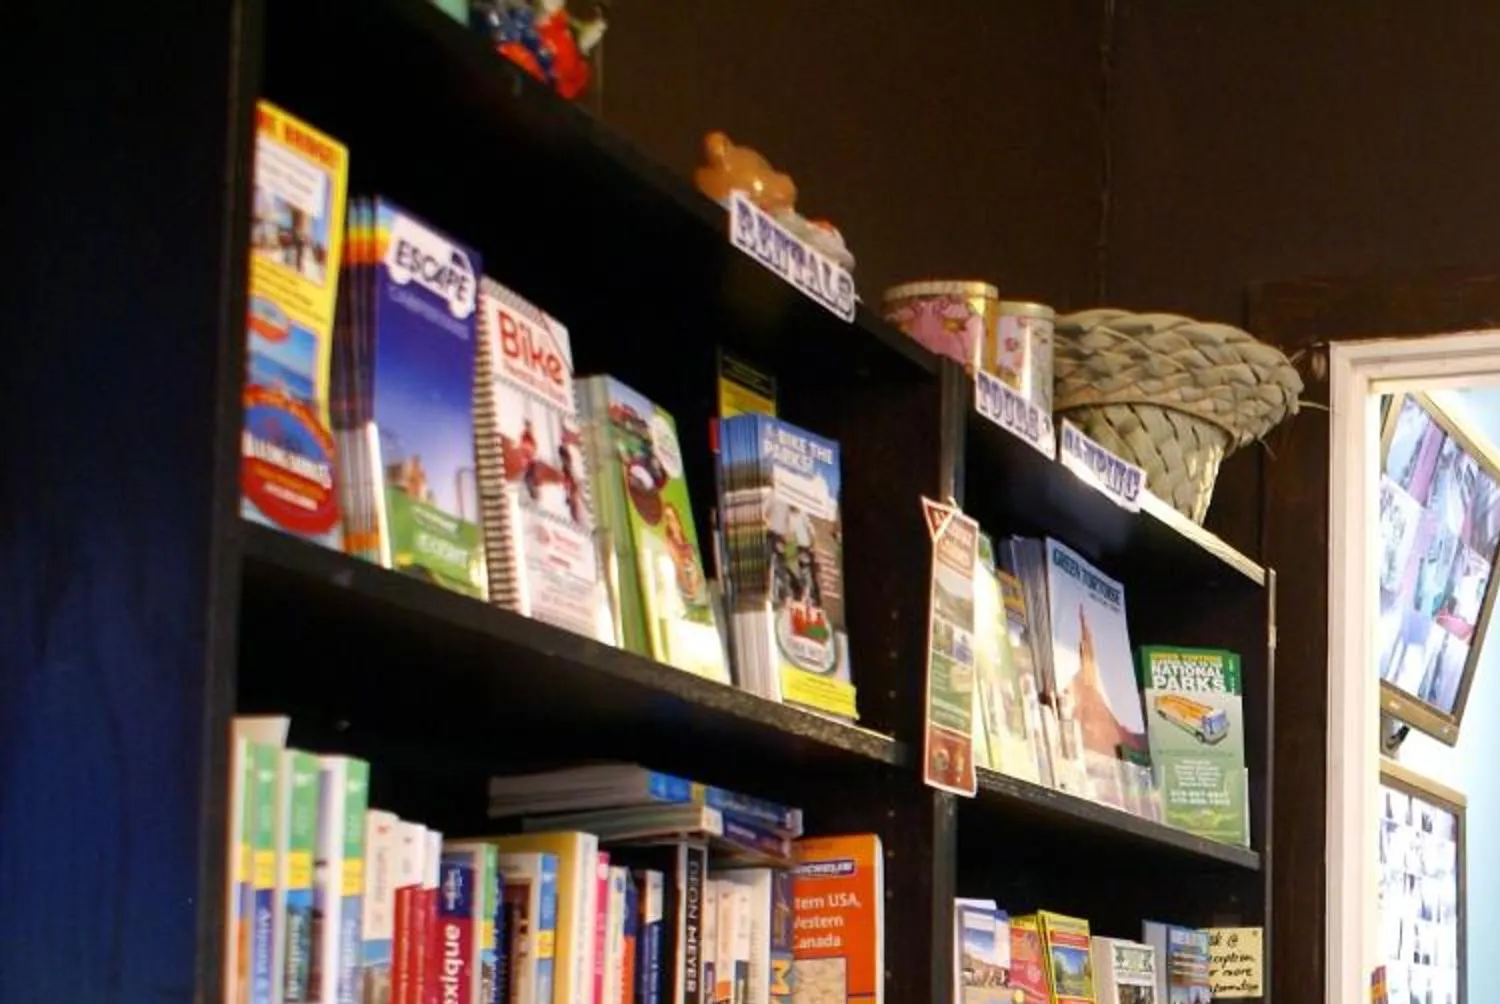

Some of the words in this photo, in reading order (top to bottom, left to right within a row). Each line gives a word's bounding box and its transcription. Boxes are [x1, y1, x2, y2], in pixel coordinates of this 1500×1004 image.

[396, 239, 469, 302] ESCAPE
[496, 308, 563, 386] Bike
[1152, 664, 1224, 678] NATIONAL
[1153, 677, 1226, 693] PARKS
[688, 861, 700, 919] DEON
[686, 924, 699, 992] MEYER
[1222, 967, 1253, 977] more
